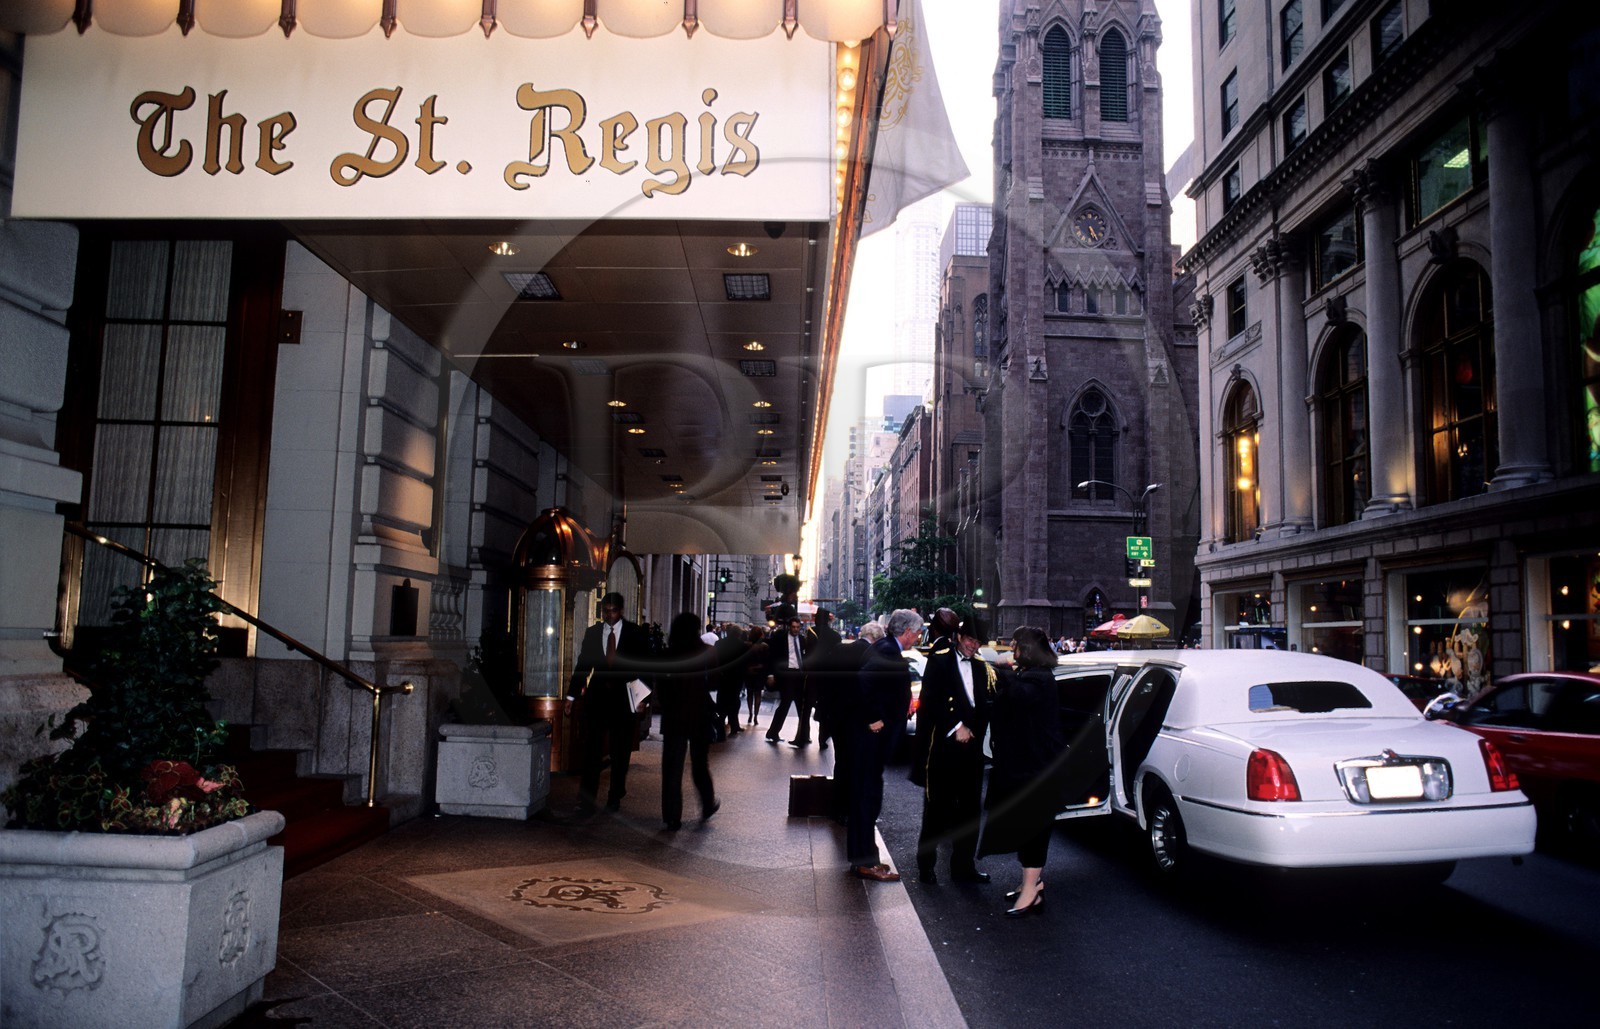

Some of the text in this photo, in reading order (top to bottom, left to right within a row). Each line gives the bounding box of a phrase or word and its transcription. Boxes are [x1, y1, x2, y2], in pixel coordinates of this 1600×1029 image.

[130, 82, 761, 199] The St. Regis
